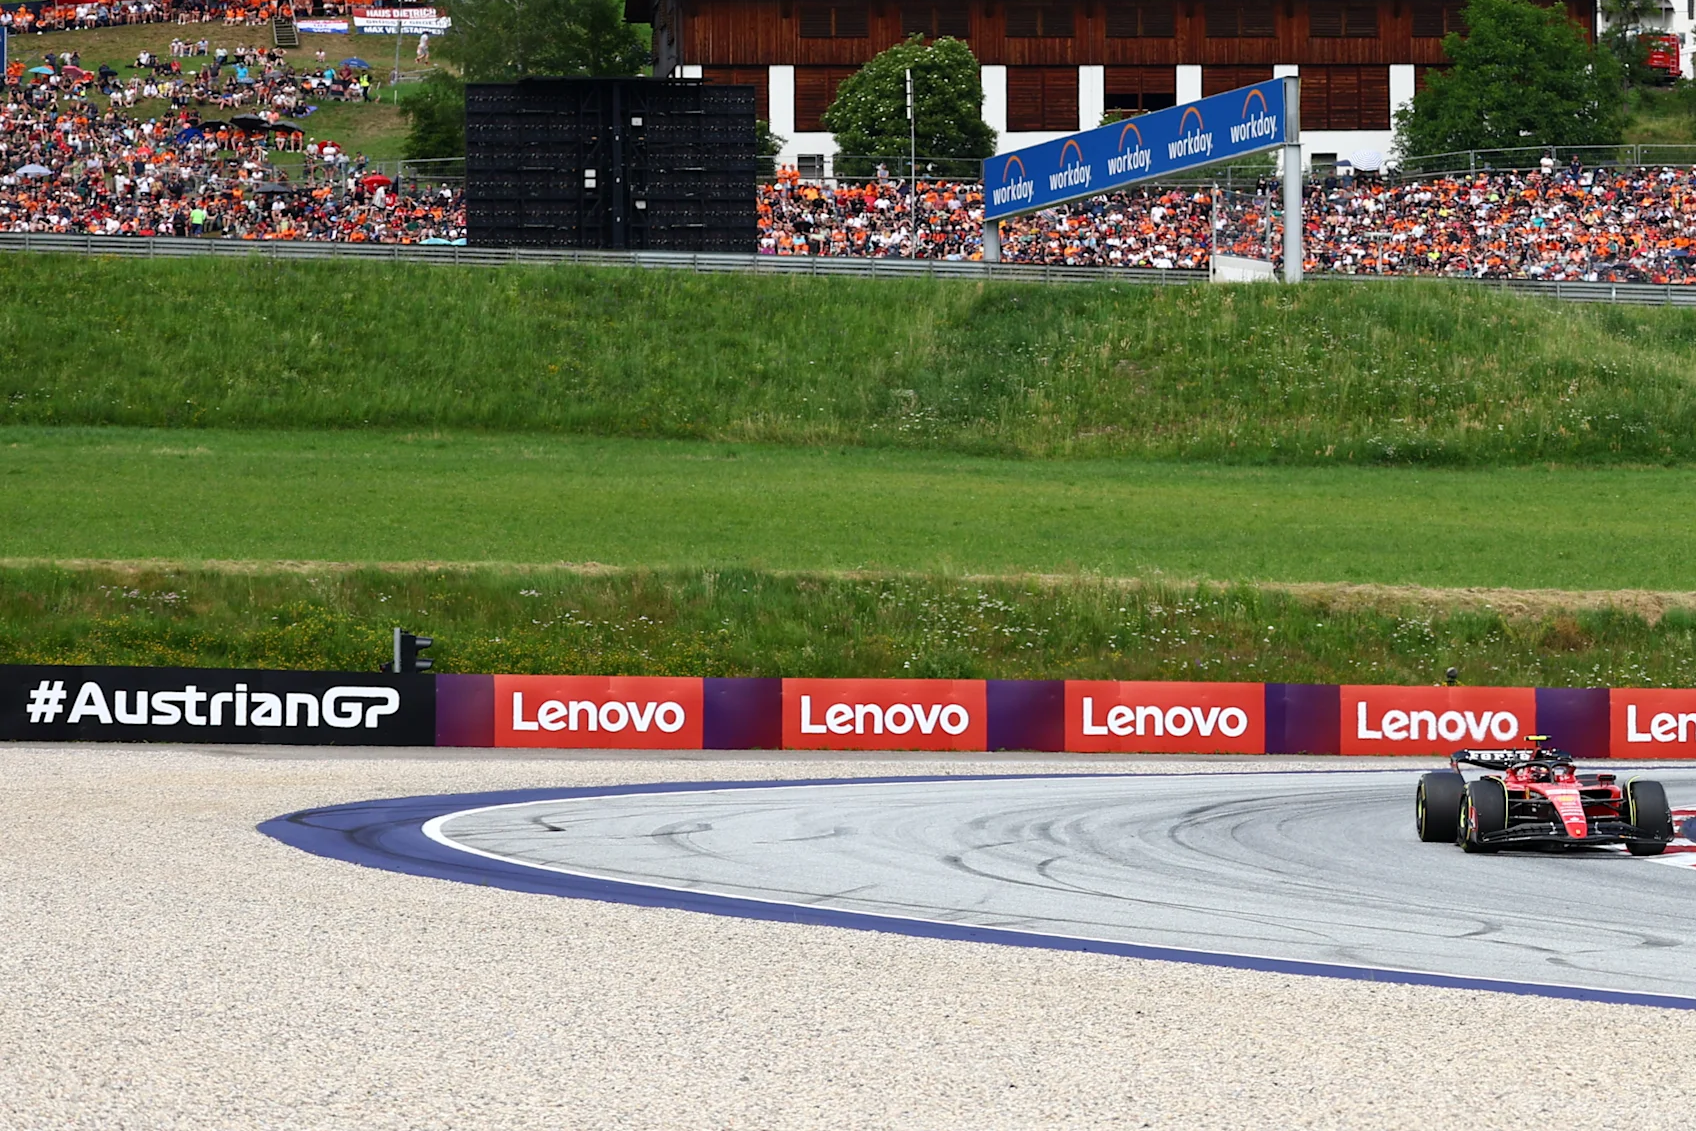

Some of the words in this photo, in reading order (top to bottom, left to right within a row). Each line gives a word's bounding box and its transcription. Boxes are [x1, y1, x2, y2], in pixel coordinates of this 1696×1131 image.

[363, 26, 384, 34] MAX
[385, 26, 445, 35] VESTAPPEN
[366, 8, 391, 18] HAUS
[27, 681, 400, 727] #AustrianGP
[513, 692, 684, 732] Lenovo
[801, 696, 968, 734] Lenovo
[1083, 697, 1247, 736] Lenovo
[1358, 702, 1518, 741] Lenovo
